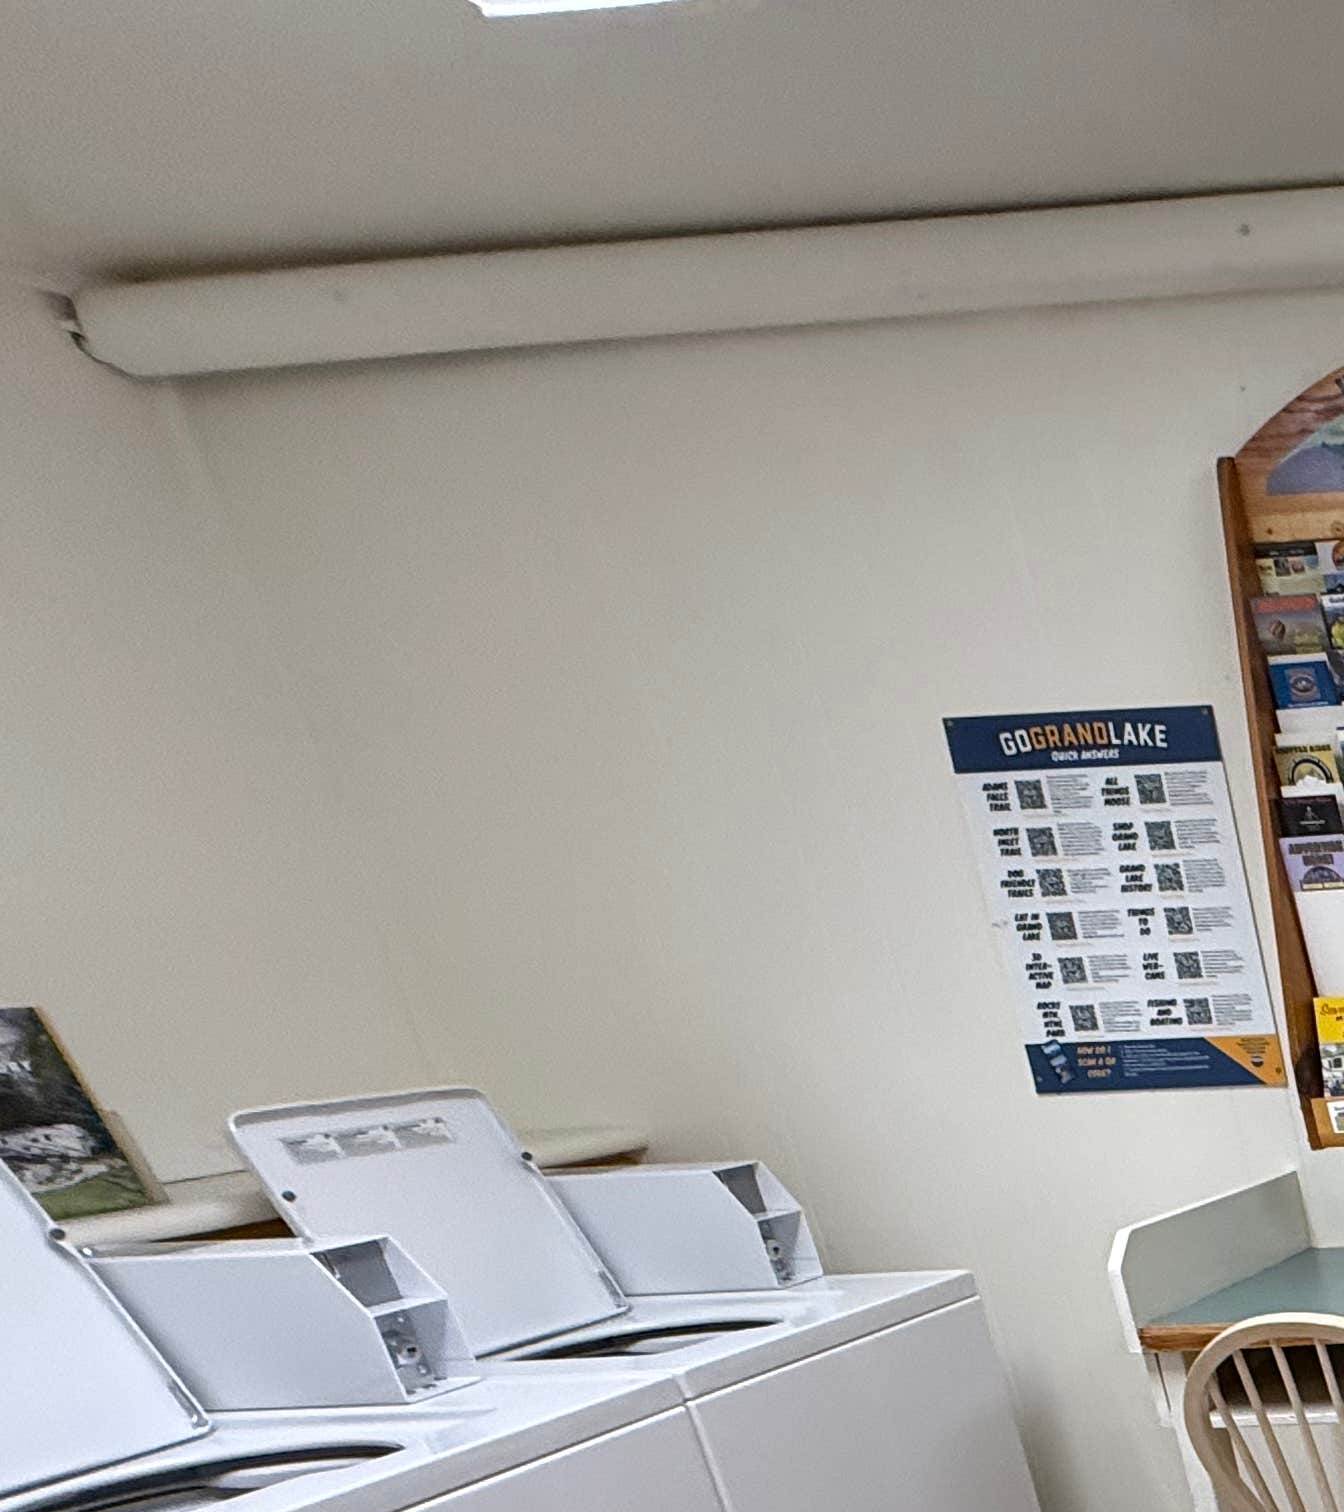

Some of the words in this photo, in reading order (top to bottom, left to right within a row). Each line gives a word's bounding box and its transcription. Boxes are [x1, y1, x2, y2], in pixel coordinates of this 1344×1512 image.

[1000, 719, 1168, 757] GOGRANDLAKE
[1051, 750, 1079, 762] QUICK
[1081, 748, 1120, 760] ANSWERS
